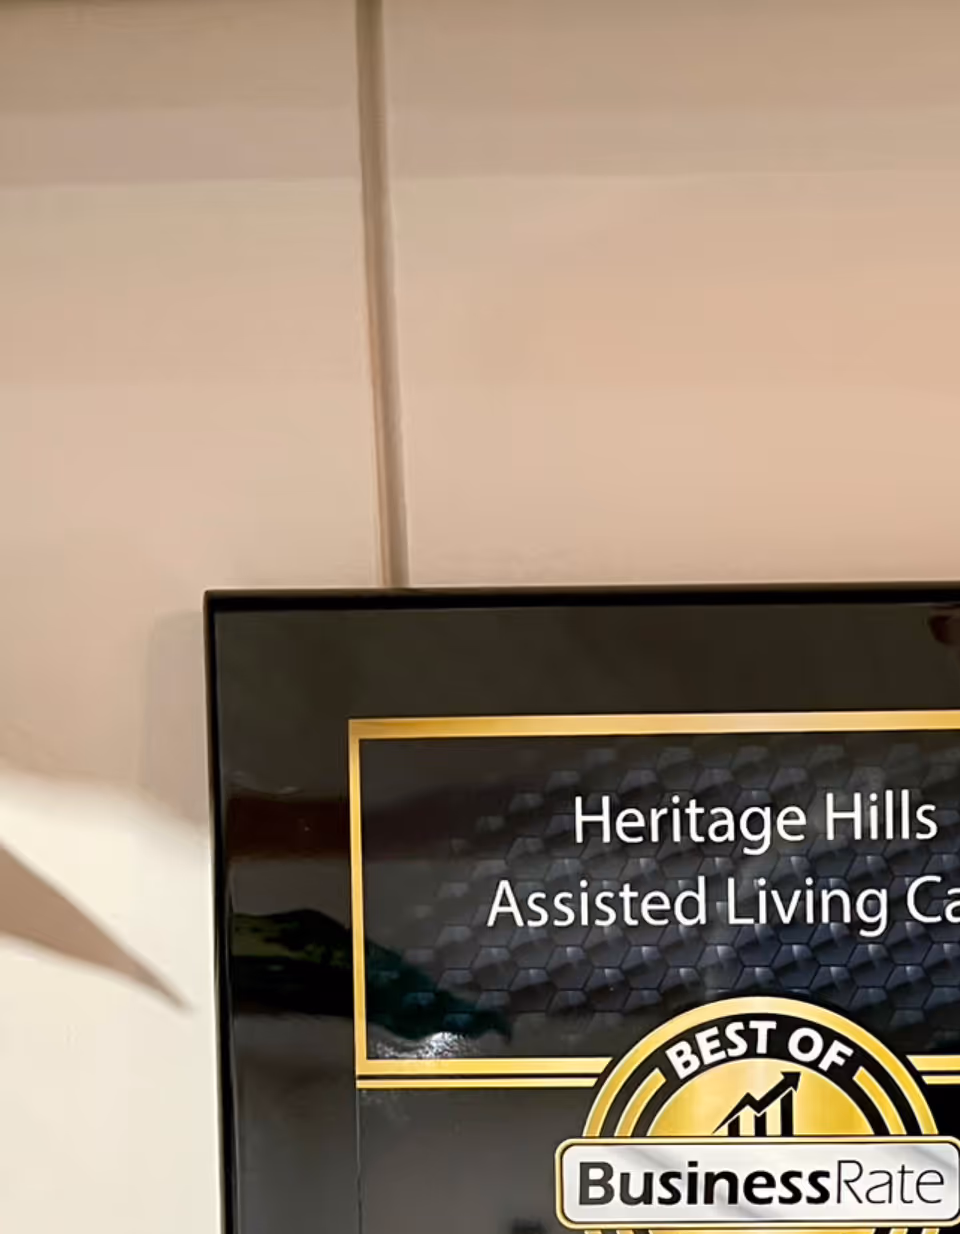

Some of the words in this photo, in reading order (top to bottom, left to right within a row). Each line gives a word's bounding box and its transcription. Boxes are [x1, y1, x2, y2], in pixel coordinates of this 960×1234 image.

[575, 794, 808, 856] Heritage
[826, 789, 938, 841] Hills
[486, 875, 708, 927] Assisted
[727, 876, 888, 938] Living
[665, 1020, 778, 1080] BEST
[786, 1027, 854, 1073] OF
[578, 1160, 944, 1206] BusinessRate
